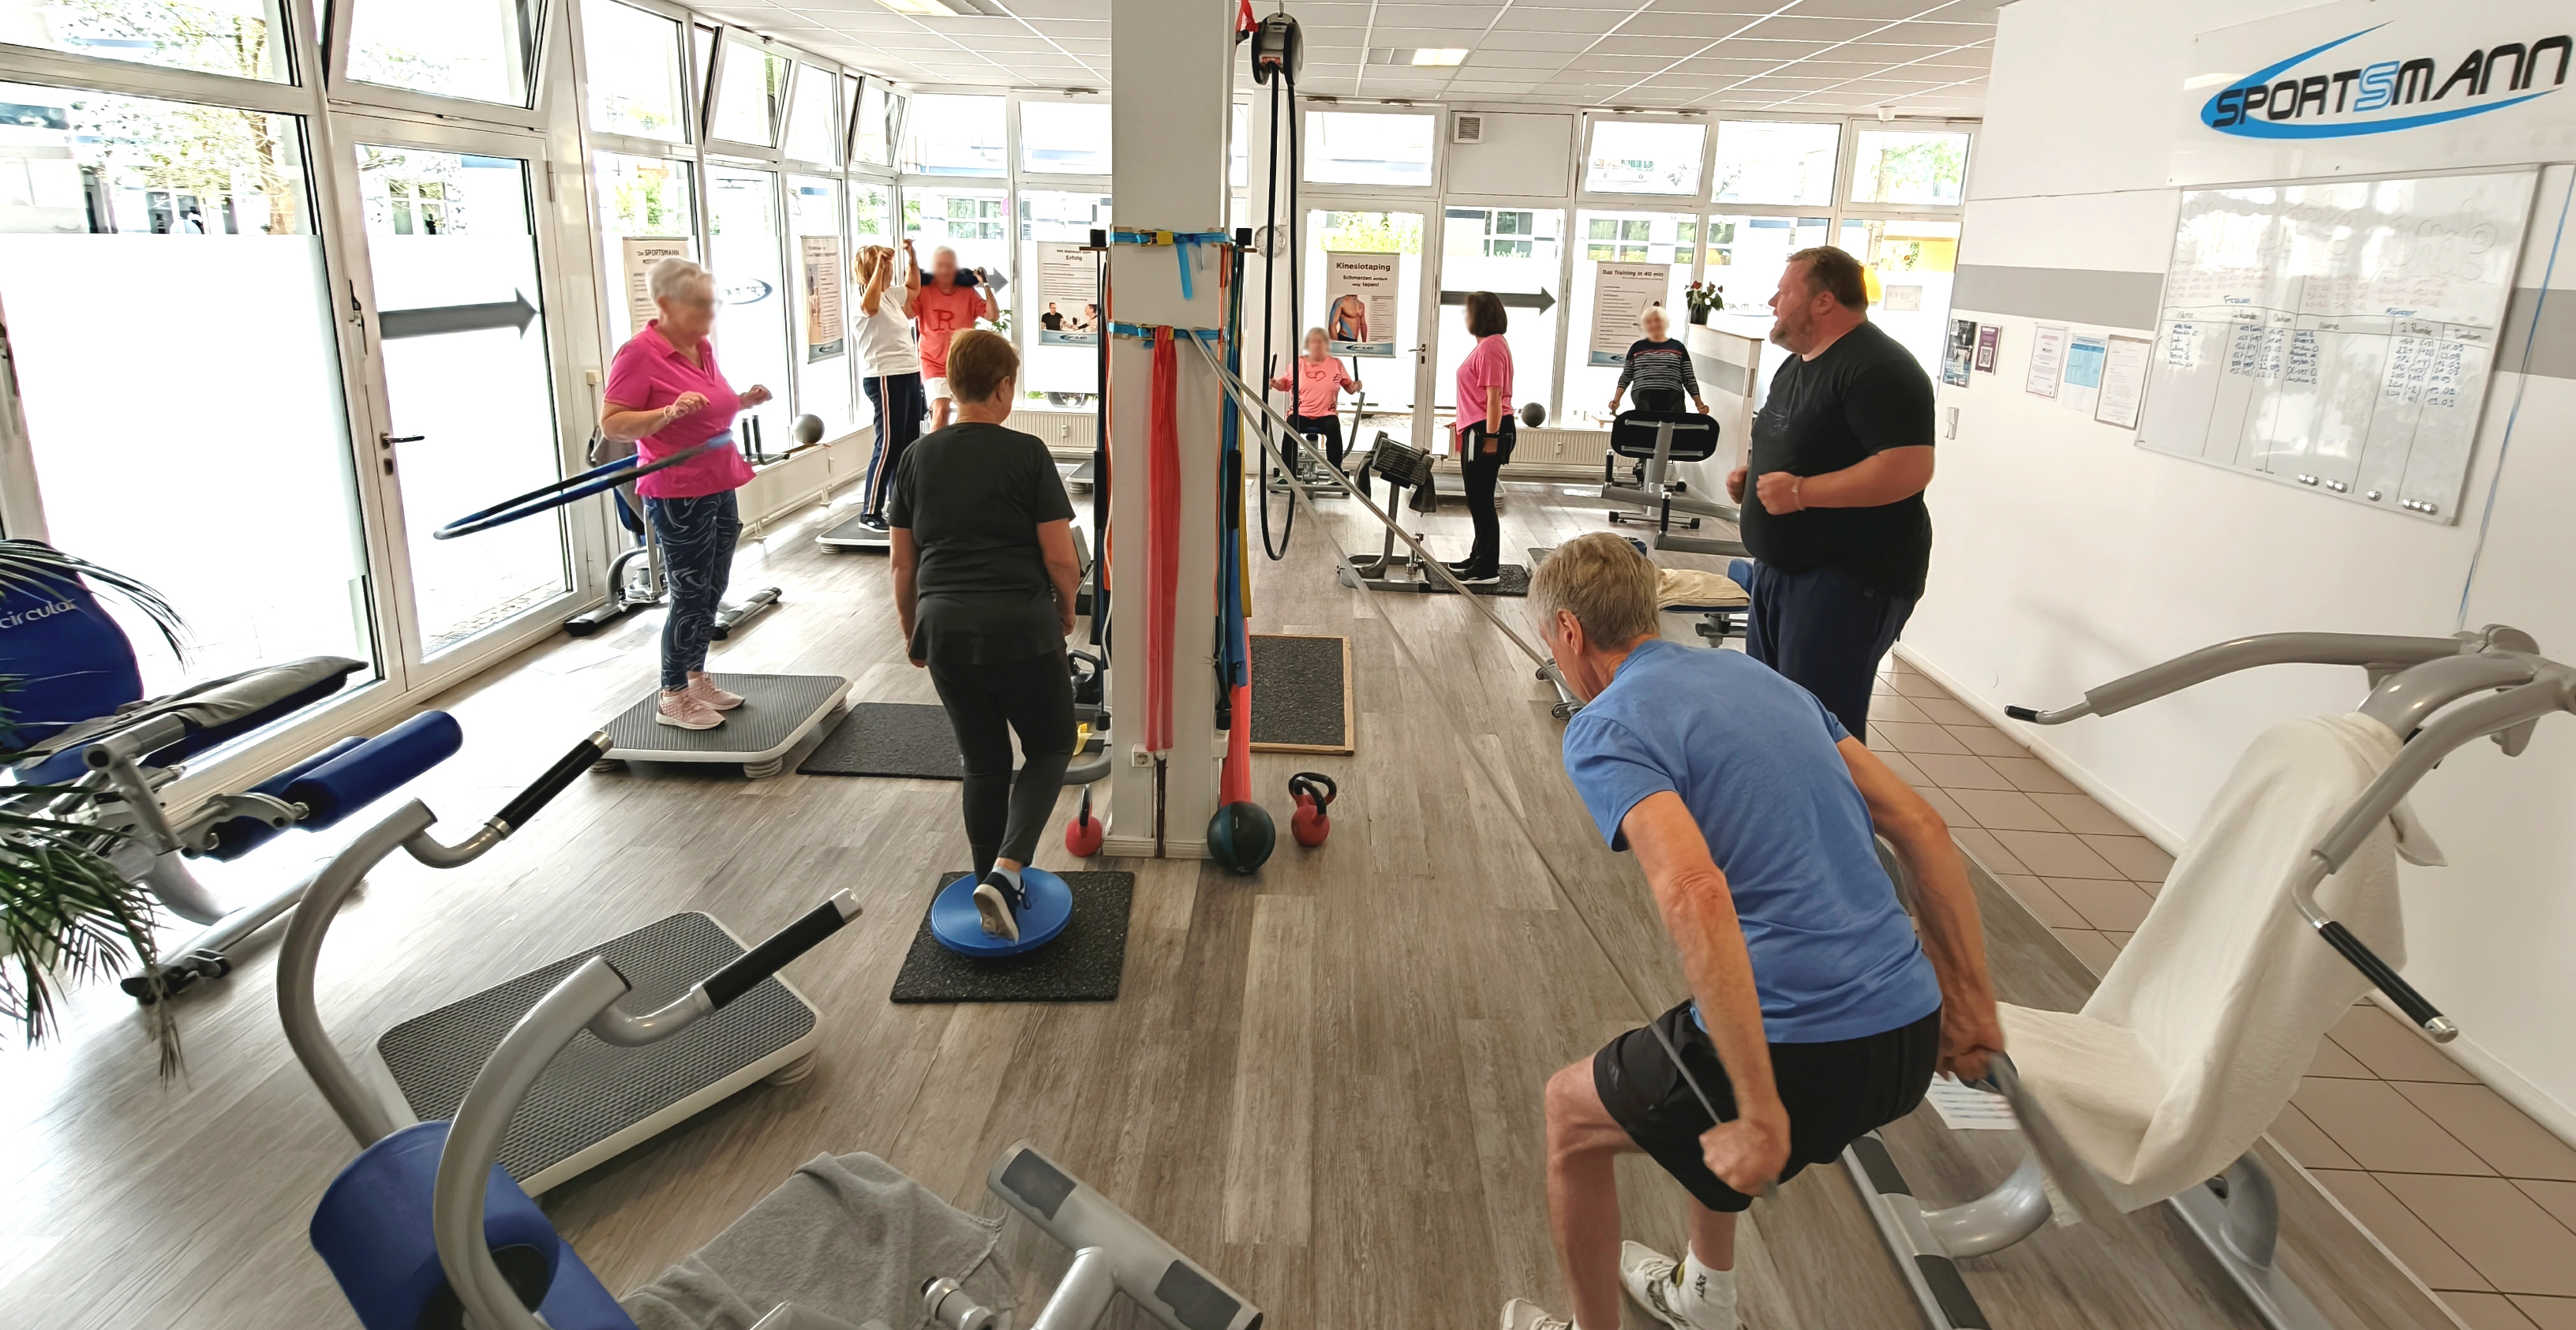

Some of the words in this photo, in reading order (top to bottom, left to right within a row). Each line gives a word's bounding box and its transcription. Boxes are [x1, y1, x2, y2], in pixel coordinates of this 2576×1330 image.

[2212, 35, 2573, 128] SPORTSMANN
[1336, 262, 1391, 272] Kinesiotaping
[933, 309, 956, 332] R
